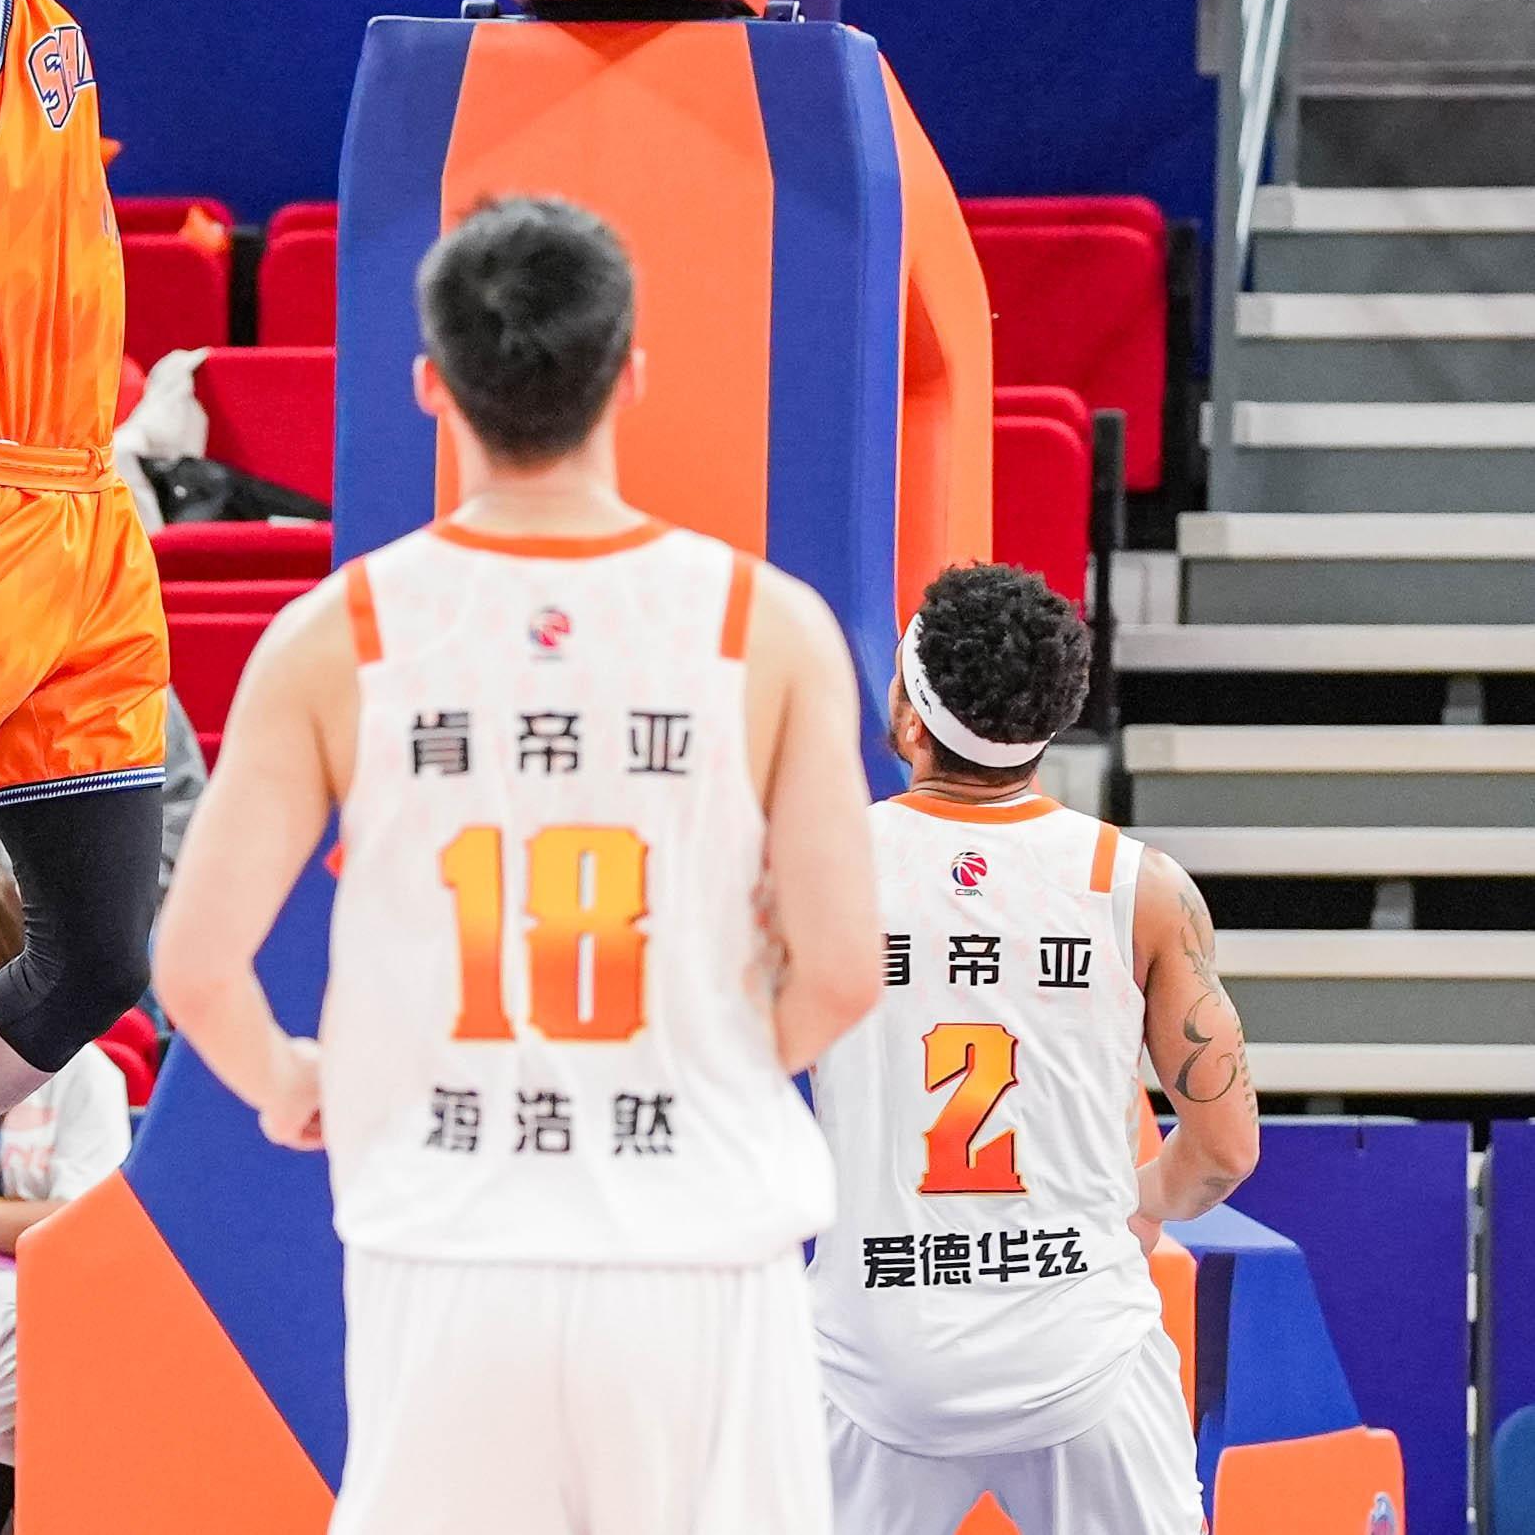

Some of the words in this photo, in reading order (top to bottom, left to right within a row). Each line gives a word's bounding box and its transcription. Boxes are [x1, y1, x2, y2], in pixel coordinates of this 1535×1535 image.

[411, 711, 690, 777] 肯帝亚
[440, 825, 650, 1042] 18
[918, 1023, 1027, 1195] 2
[863, 1227, 1087, 1288] 爱德华兹
